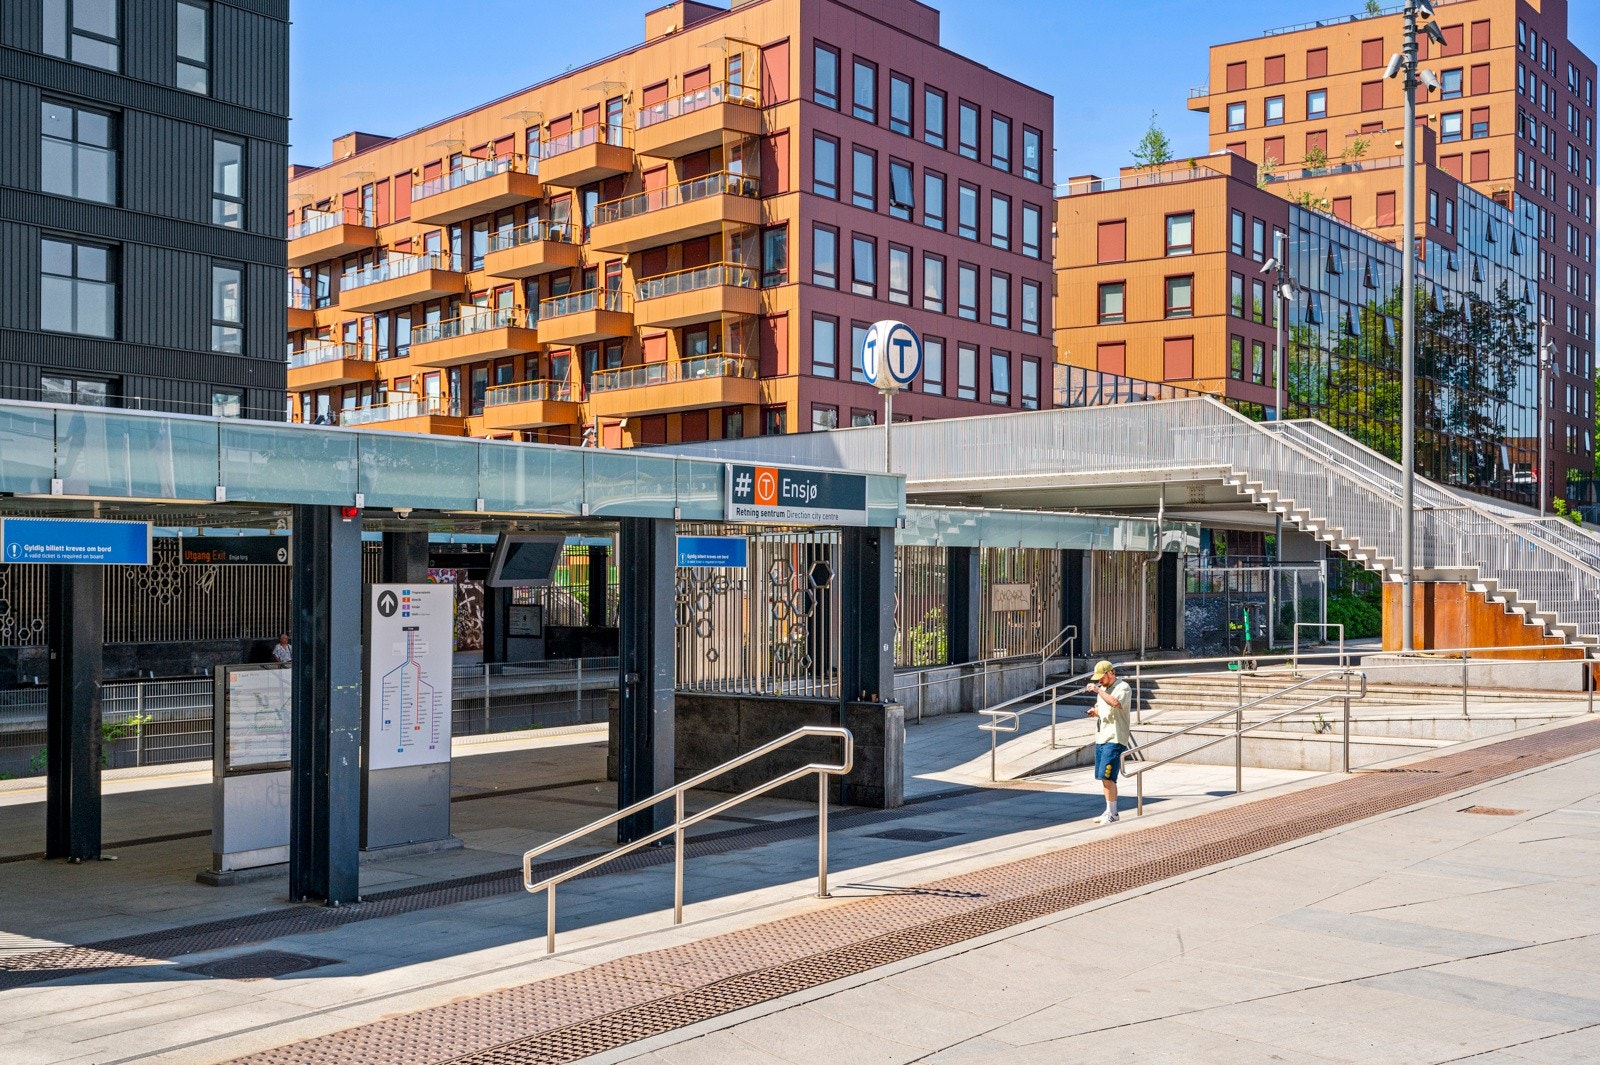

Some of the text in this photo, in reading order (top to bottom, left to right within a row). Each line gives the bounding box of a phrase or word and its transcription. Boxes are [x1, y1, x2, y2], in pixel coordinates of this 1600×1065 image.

[868, 339, 876, 374] T
[893, 338, 912, 373] T
[782, 478, 818, 504] Ensjø
[736, 507, 839, 521] Retning sentrum Direction city centre
[24, 544, 44, 553] Gyldig
[45, 544, 64, 552] billett
[184, 550, 211, 562] Utgang
[212, 549, 226, 560] Exit
